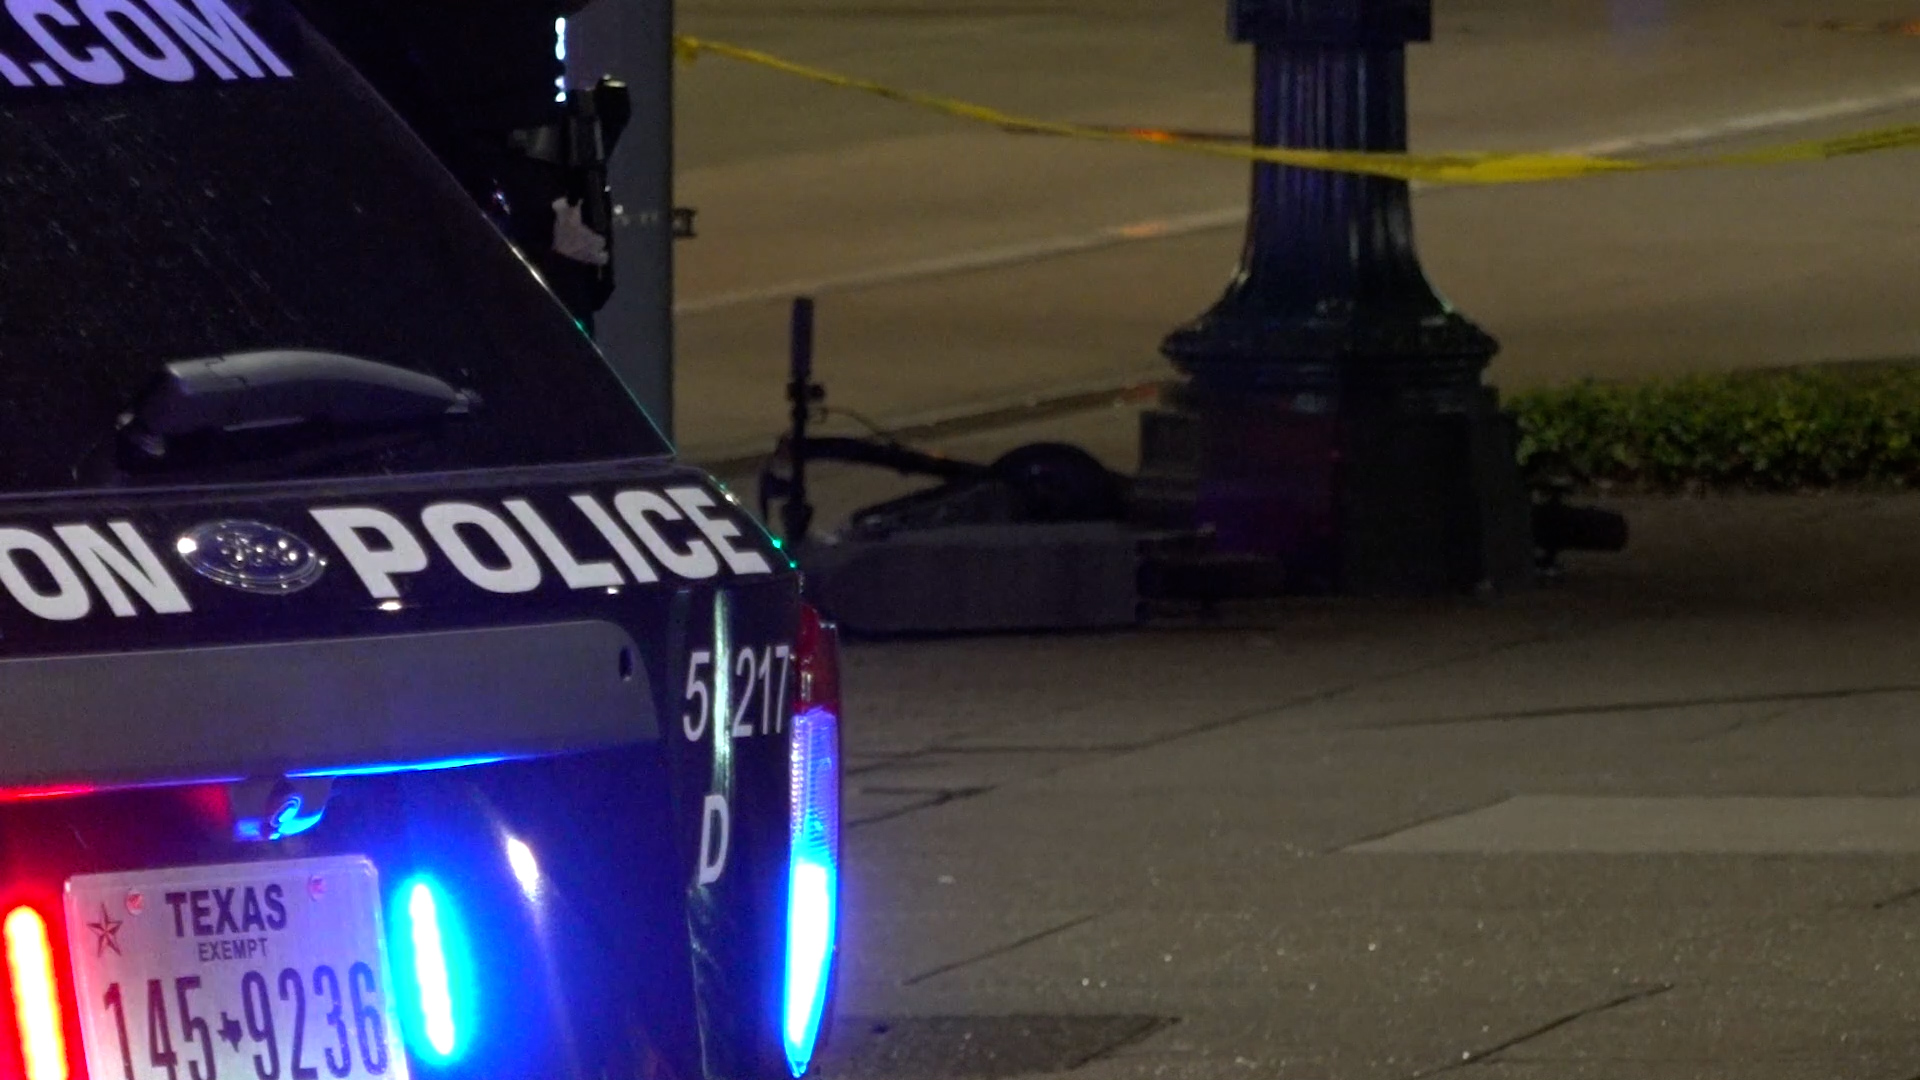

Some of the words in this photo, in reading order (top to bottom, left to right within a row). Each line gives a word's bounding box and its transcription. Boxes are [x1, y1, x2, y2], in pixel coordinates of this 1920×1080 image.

[0, 0, 294, 86] .COM
[0, 521, 192, 621] ON
[309, 487, 772, 599] POLICE
[697, 794, 730, 888] D
[165, 883, 287, 938] TEXAS
[198, 938, 268, 962] EXEMPT
